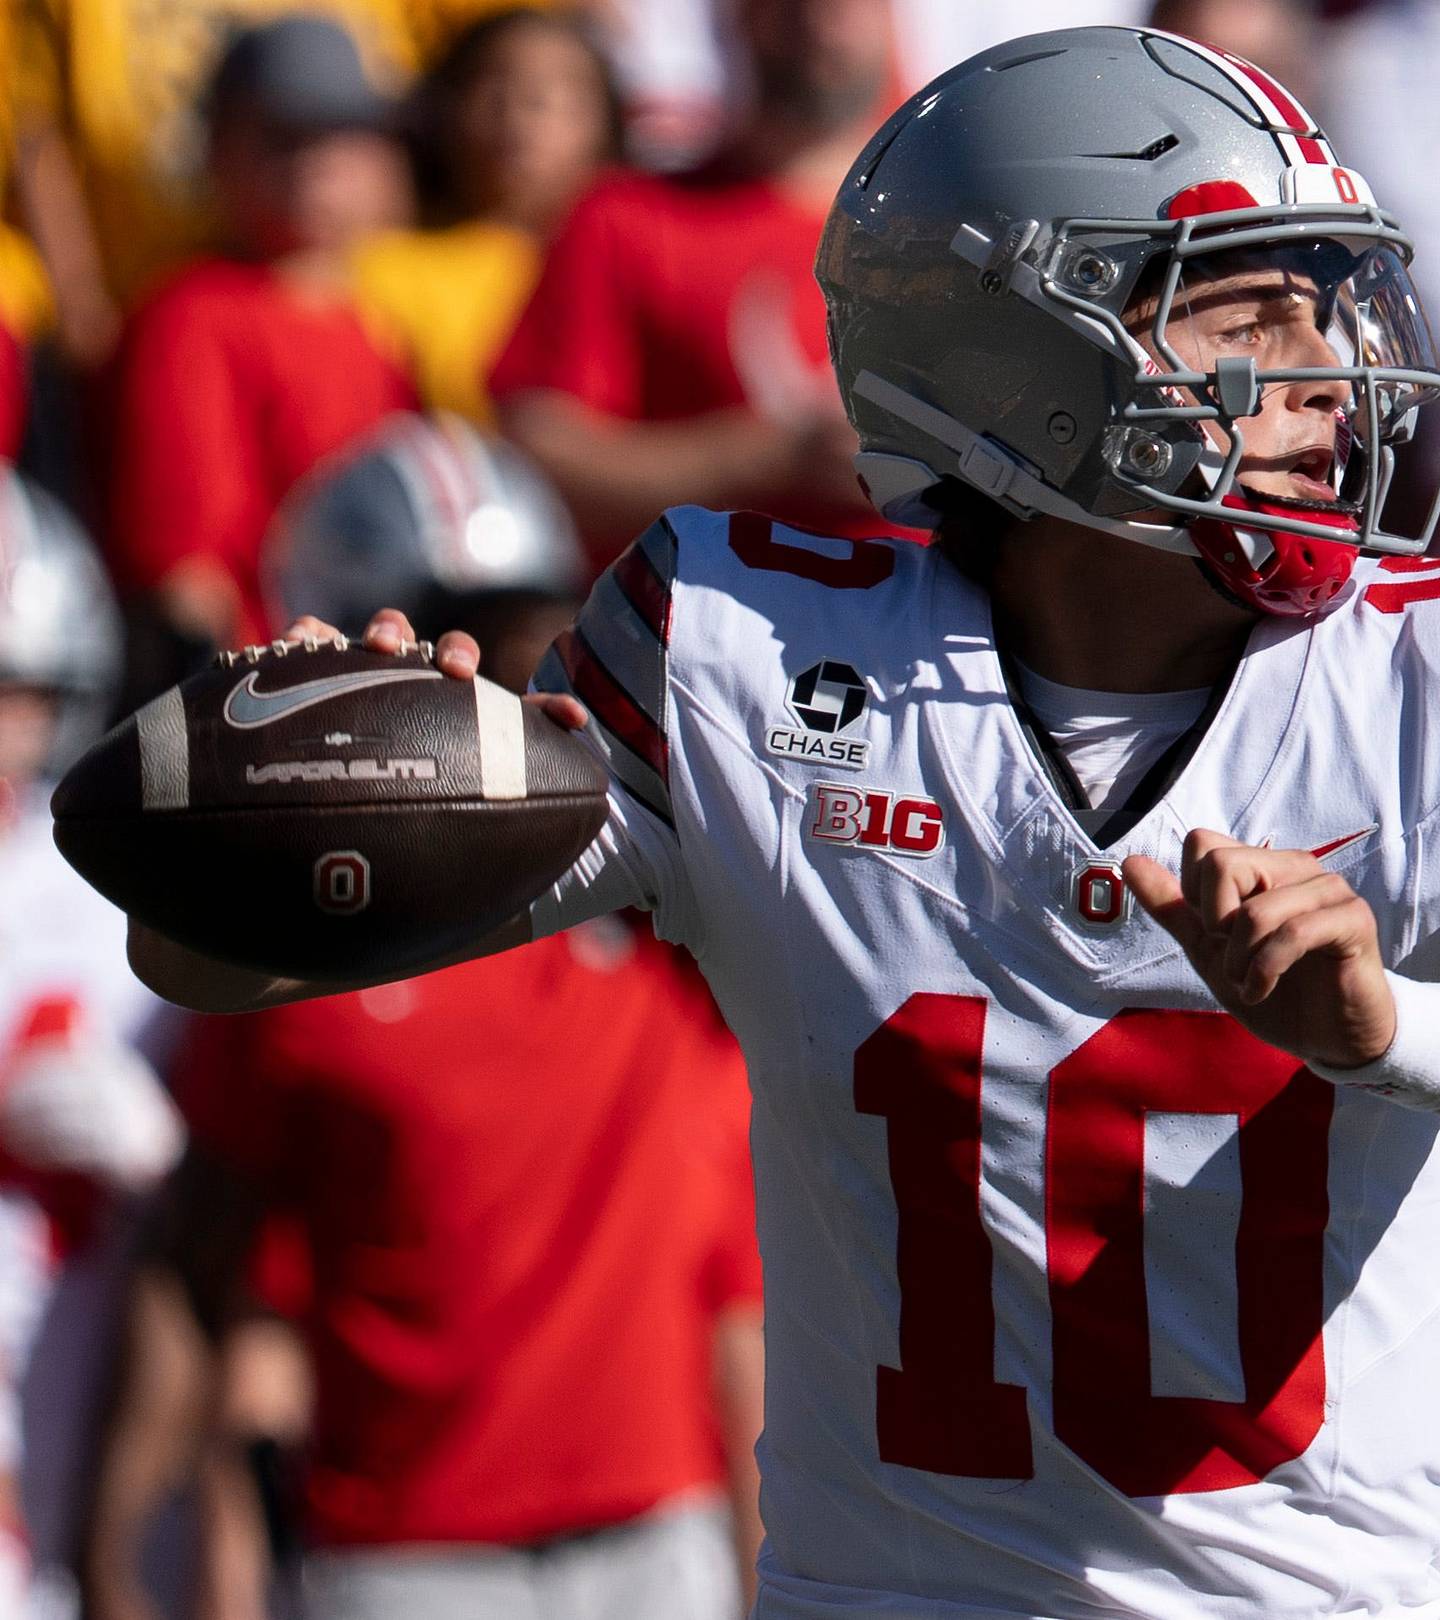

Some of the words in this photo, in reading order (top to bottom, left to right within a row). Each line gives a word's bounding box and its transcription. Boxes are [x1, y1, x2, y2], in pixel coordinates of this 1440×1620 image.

[769, 729, 866, 764] CHASE
[246, 760, 350, 785] VAPOR
[350, 757, 437, 780] ELITE
[853, 991, 1336, 1499] 10
